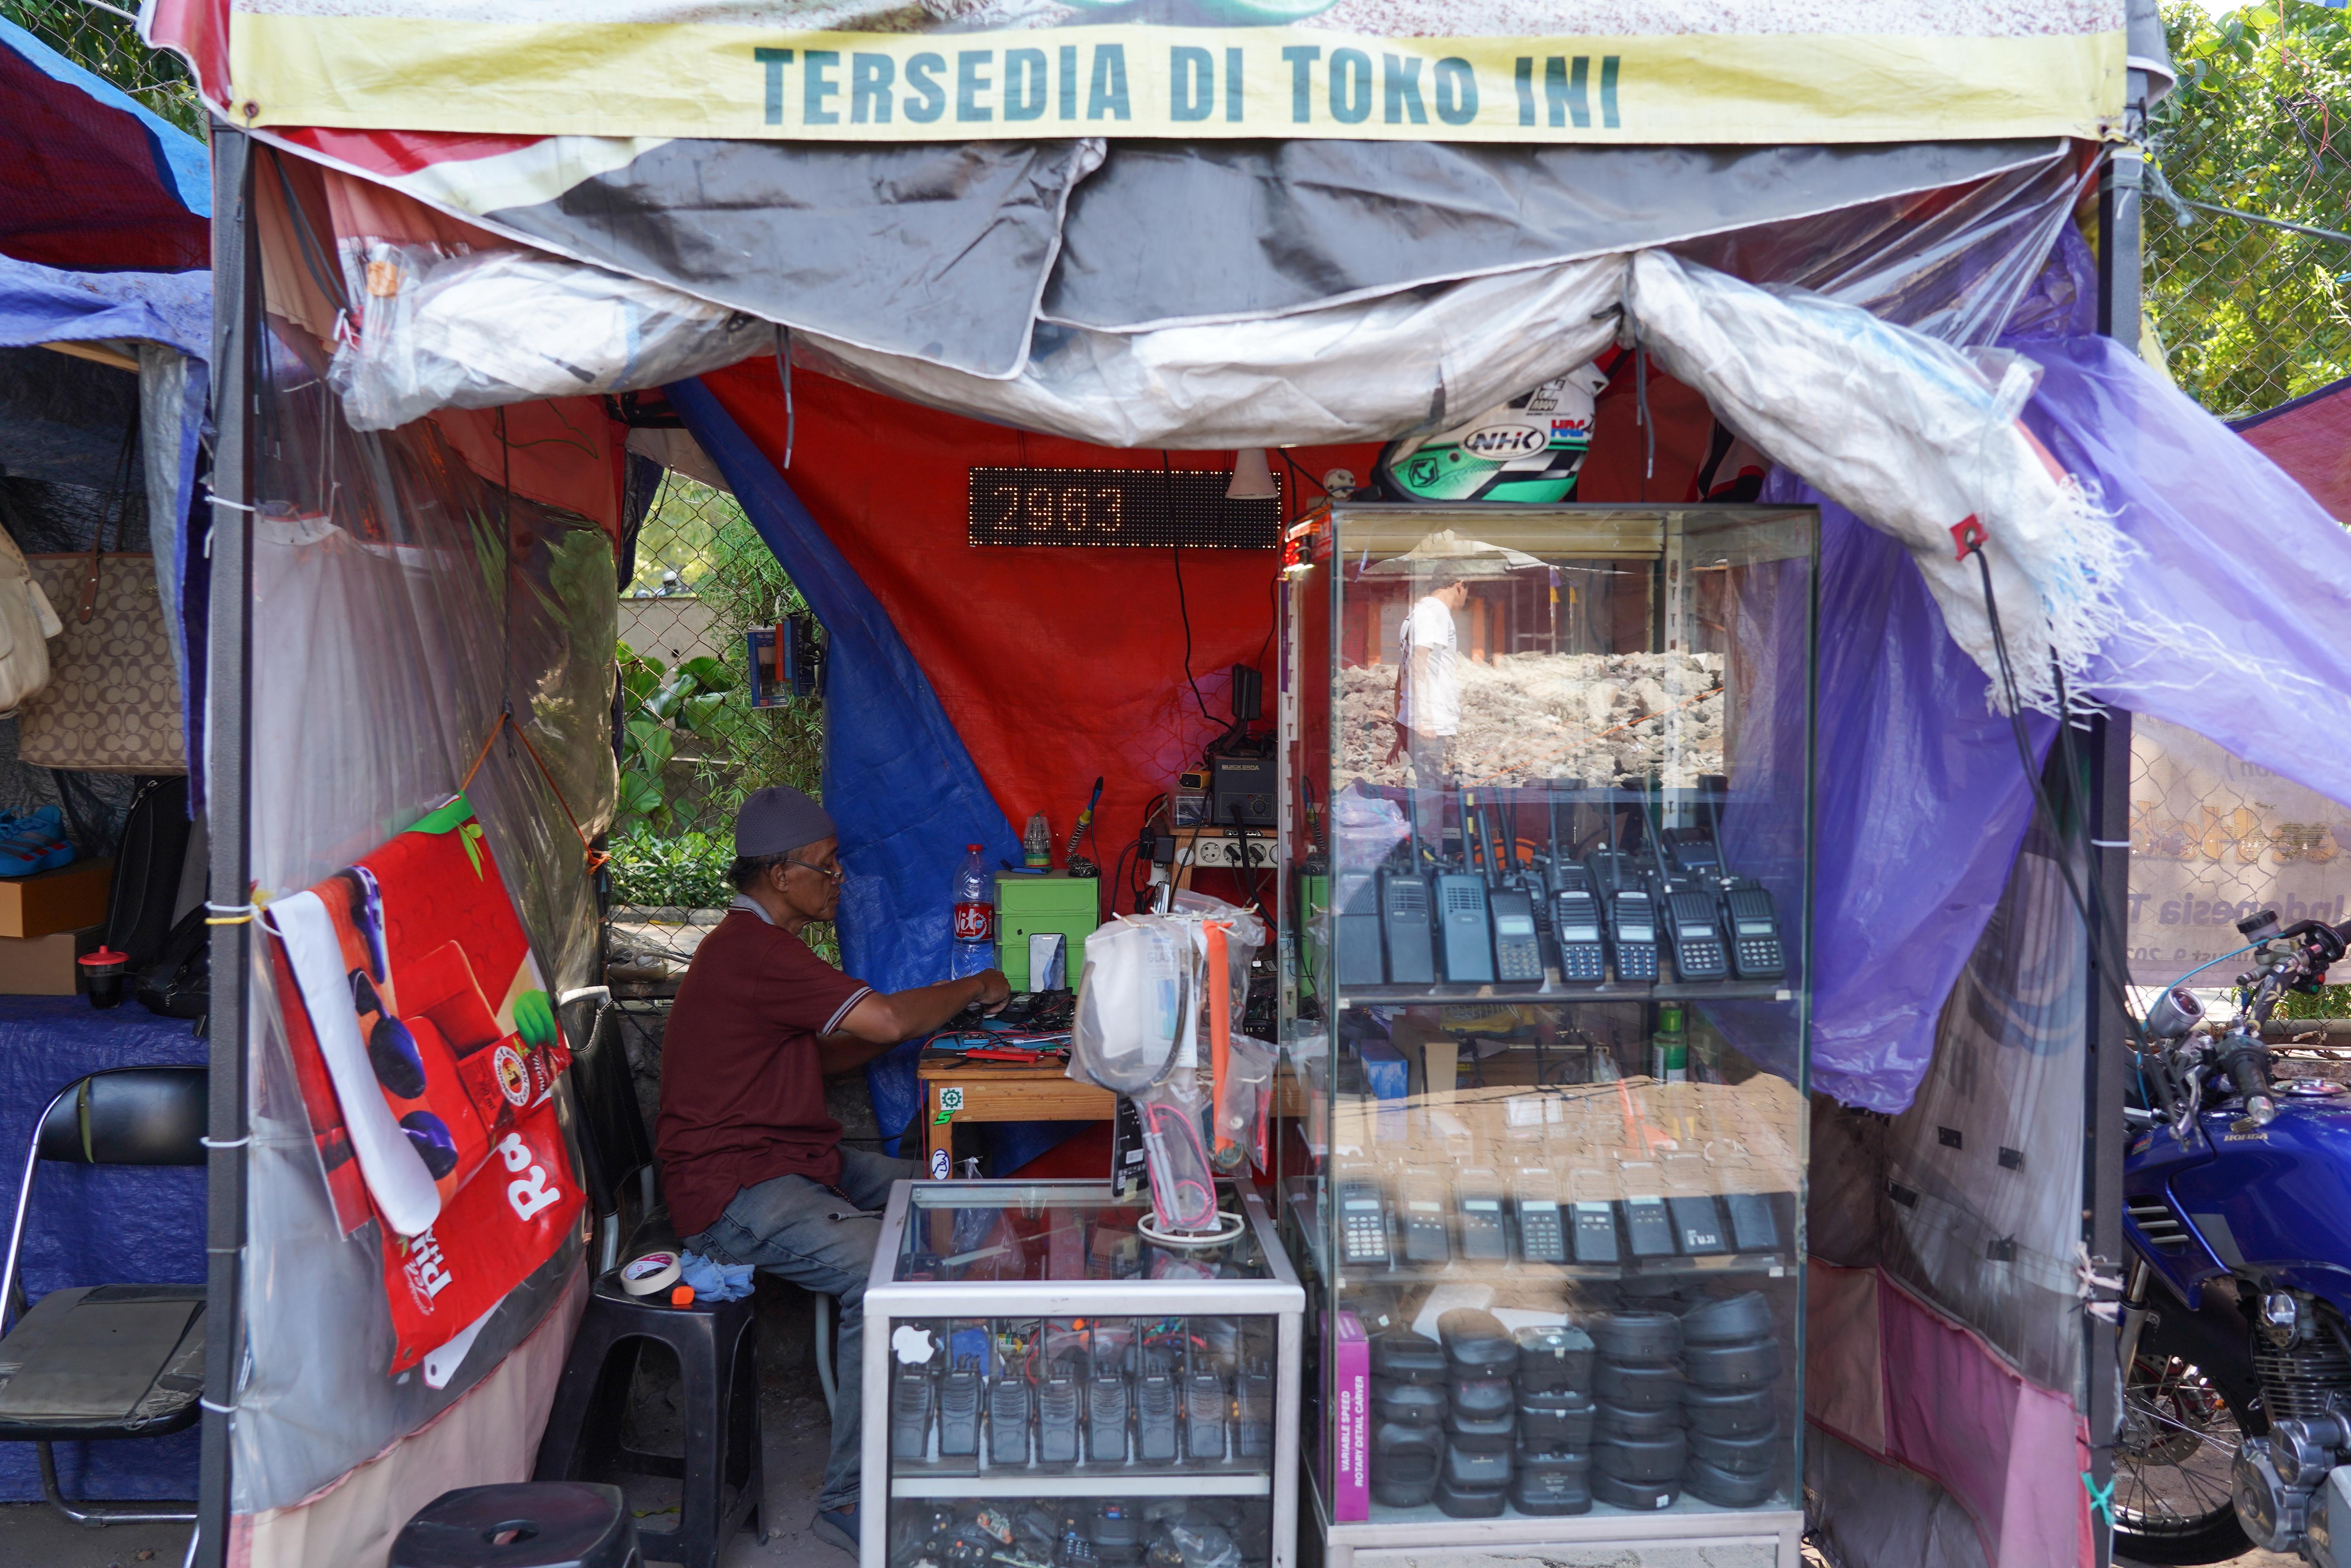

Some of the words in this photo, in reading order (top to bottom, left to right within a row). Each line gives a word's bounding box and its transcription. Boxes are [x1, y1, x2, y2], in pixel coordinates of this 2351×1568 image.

[754, 42, 1131, 125] TERSEDIA
[1170, 46, 1243, 122] DI
[1282, 45, 1478, 125] TOKO
[1515, 55, 1621, 129] INI
[1471, 430, 1538, 450] NHK
[1551, 419, 1585, 437] HRC
[993, 487, 1121, 531] 2963
[2224, 1133, 2268, 1142] HONDA
[410, 1235, 452, 1298] PU
[1341, 1390, 1351, 1423] SPEED
[1354, 1375, 1364, 1414] CARVER
[1341, 1424, 1350, 1472] VARIABLE
[1354, 1415, 1364, 1448] DETAIL
[1354, 1449, 1364, 1488] ROTARY
